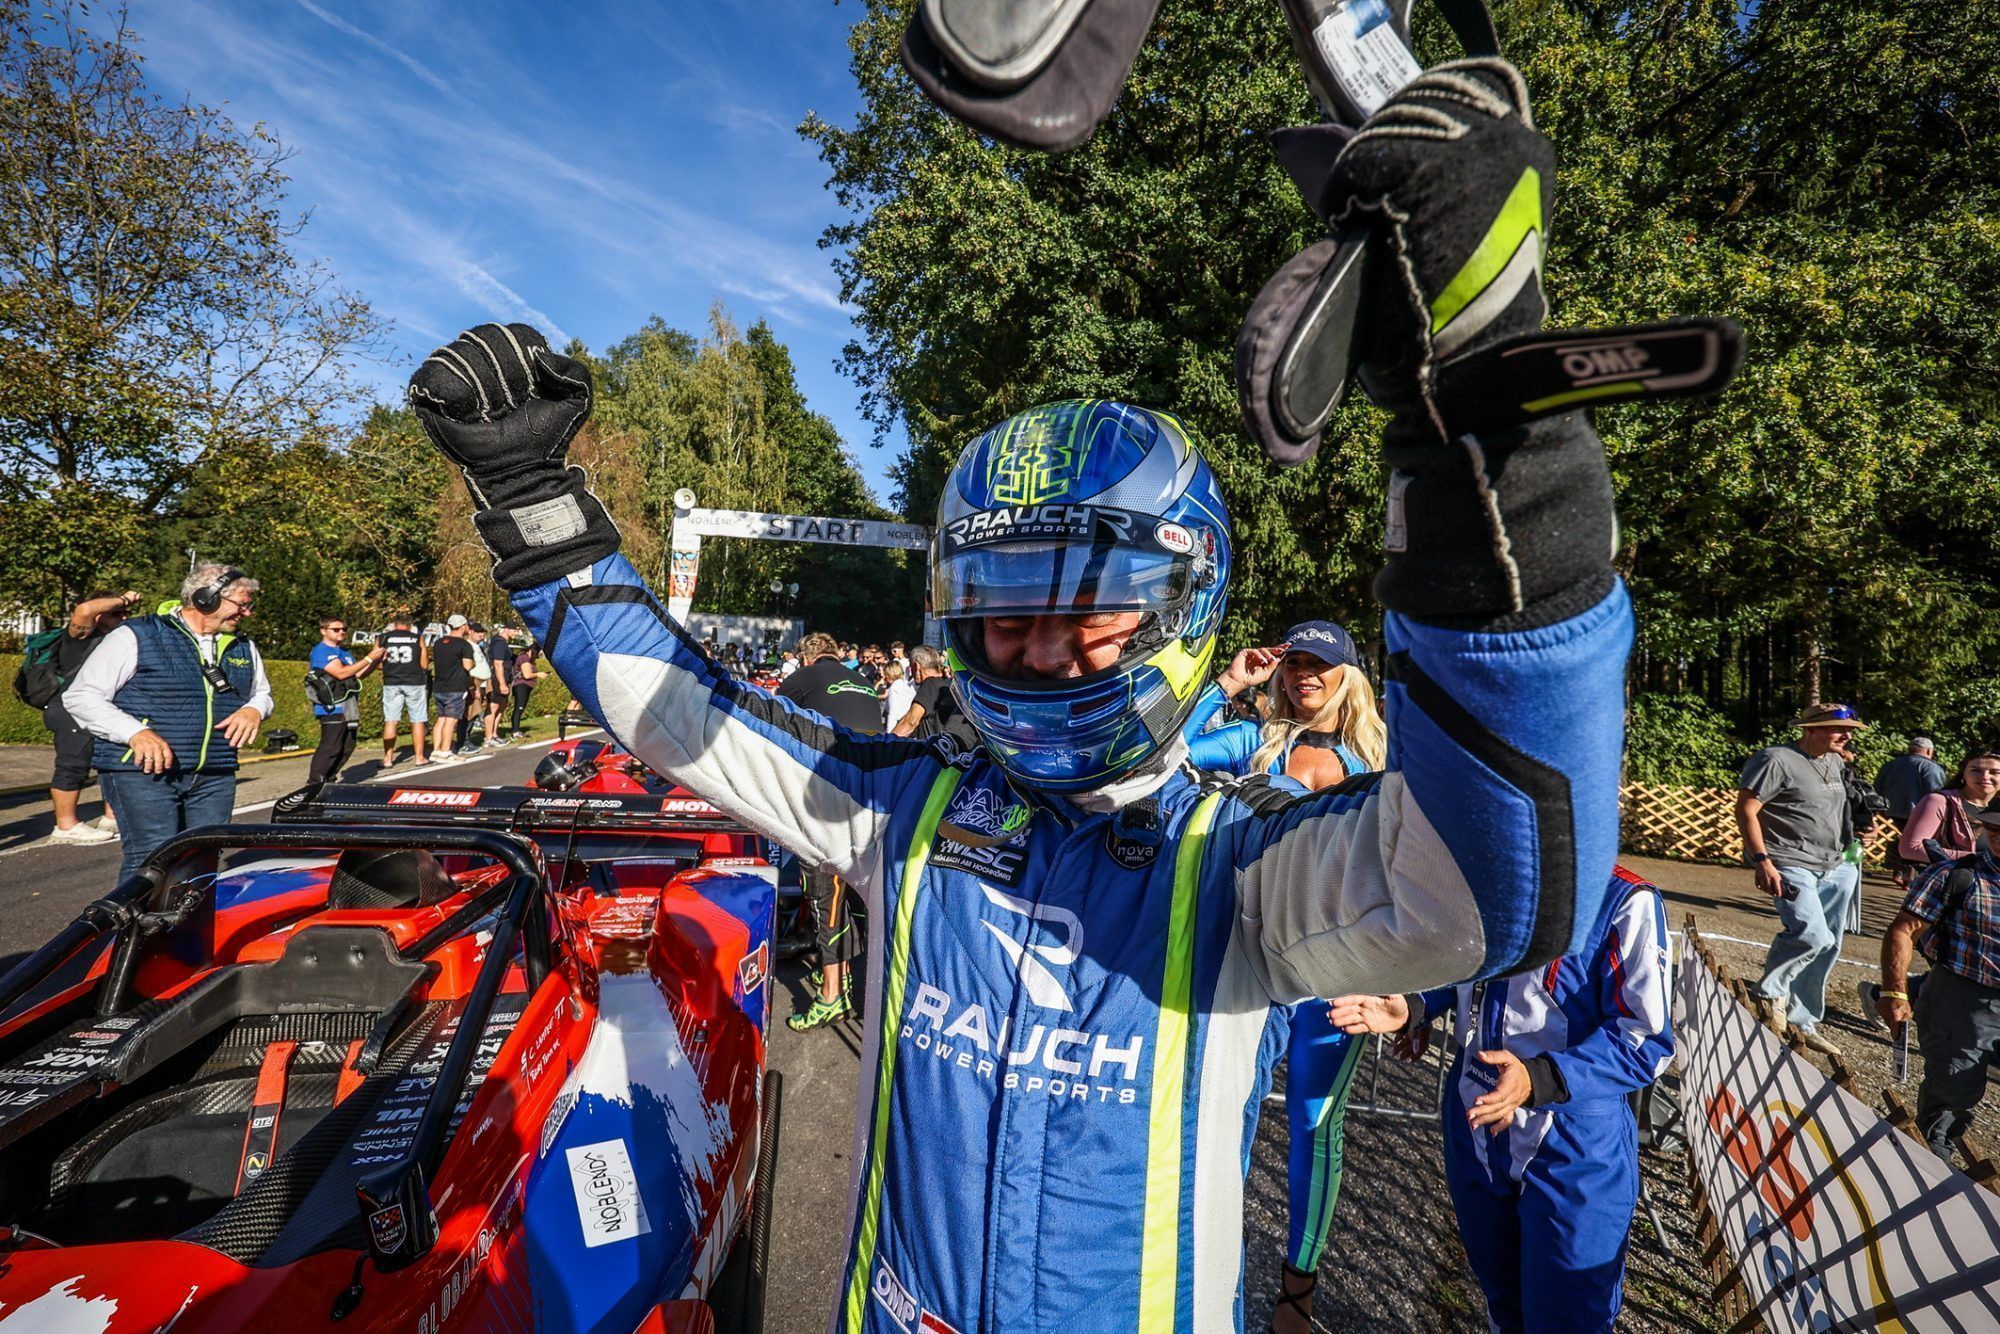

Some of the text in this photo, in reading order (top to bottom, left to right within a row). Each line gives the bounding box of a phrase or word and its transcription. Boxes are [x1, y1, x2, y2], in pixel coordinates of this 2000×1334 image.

[1562, 347, 1650, 379] OMP
[969, 505, 1093, 533] RAUCH
[767, 516, 865, 543] START
[967, 525, 1088, 542] POWER SPORTS
[1164, 529, 1188, 546] BELL
[387, 645, 413, 664] 33
[393, 791, 474, 806] MOTUL
[1116, 843, 1154, 858] nova
[1124, 854, 1145, 863] proto
[960, 857, 973, 868] AM
[908, 982, 1143, 1081] RAUCH
[24, 1052, 106, 1068] NGK
[900, 1025, 1137, 1105] POWER SPORTS
[876, 1267, 915, 1323] OMP
